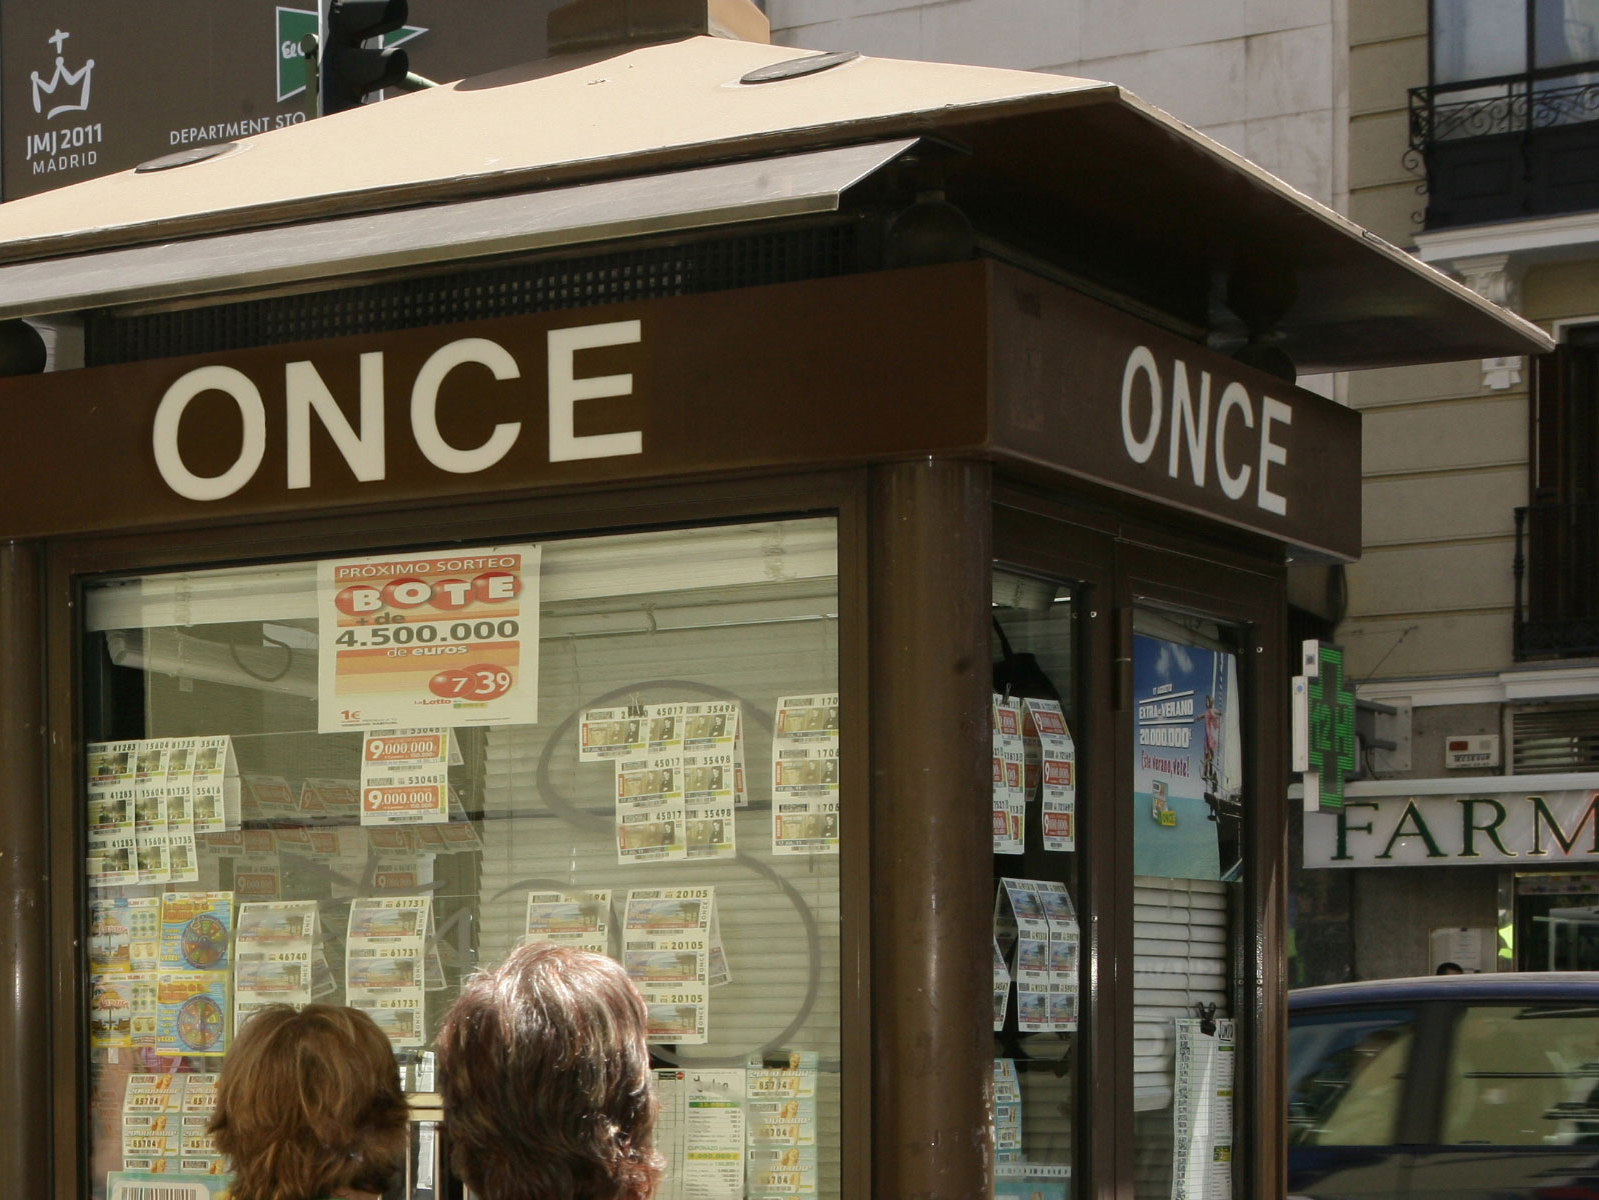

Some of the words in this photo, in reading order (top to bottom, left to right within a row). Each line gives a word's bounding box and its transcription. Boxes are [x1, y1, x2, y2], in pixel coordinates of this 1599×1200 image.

[170, 117, 269, 145] DEPARTMENT
[276, 111, 306, 129] STO
[27, 131, 58, 160] JMJ
[61, 123, 102, 149] 2011
[33, 151, 97, 174] MADRID
[152, 319, 643, 501] ONCE
[1121, 345, 1292, 516] ONCE
[339, 562, 430, 578] PRÓXIMO
[436, 557, 516, 572] SORTEO
[352, 575, 514, 612] BOTE
[375, 612, 406, 625] de
[335, 619, 520, 648] 4.500.000
[387, 647, 407, 657] de
[412, 645, 467, 657] euros
[451, 677, 468, 693] 7
[475, 671, 510, 695] 39
[341, 710, 361, 720] 1€
[657, 706, 683, 716] 45017
[1162, 699, 1193, 717] VERANO
[655, 757, 680, 768] 45017
[656, 811, 682, 821] 45017
[676, 890, 708, 898] 20105
[671, 941, 703, 950] 20105
[671, 995, 703, 1003] 20105
